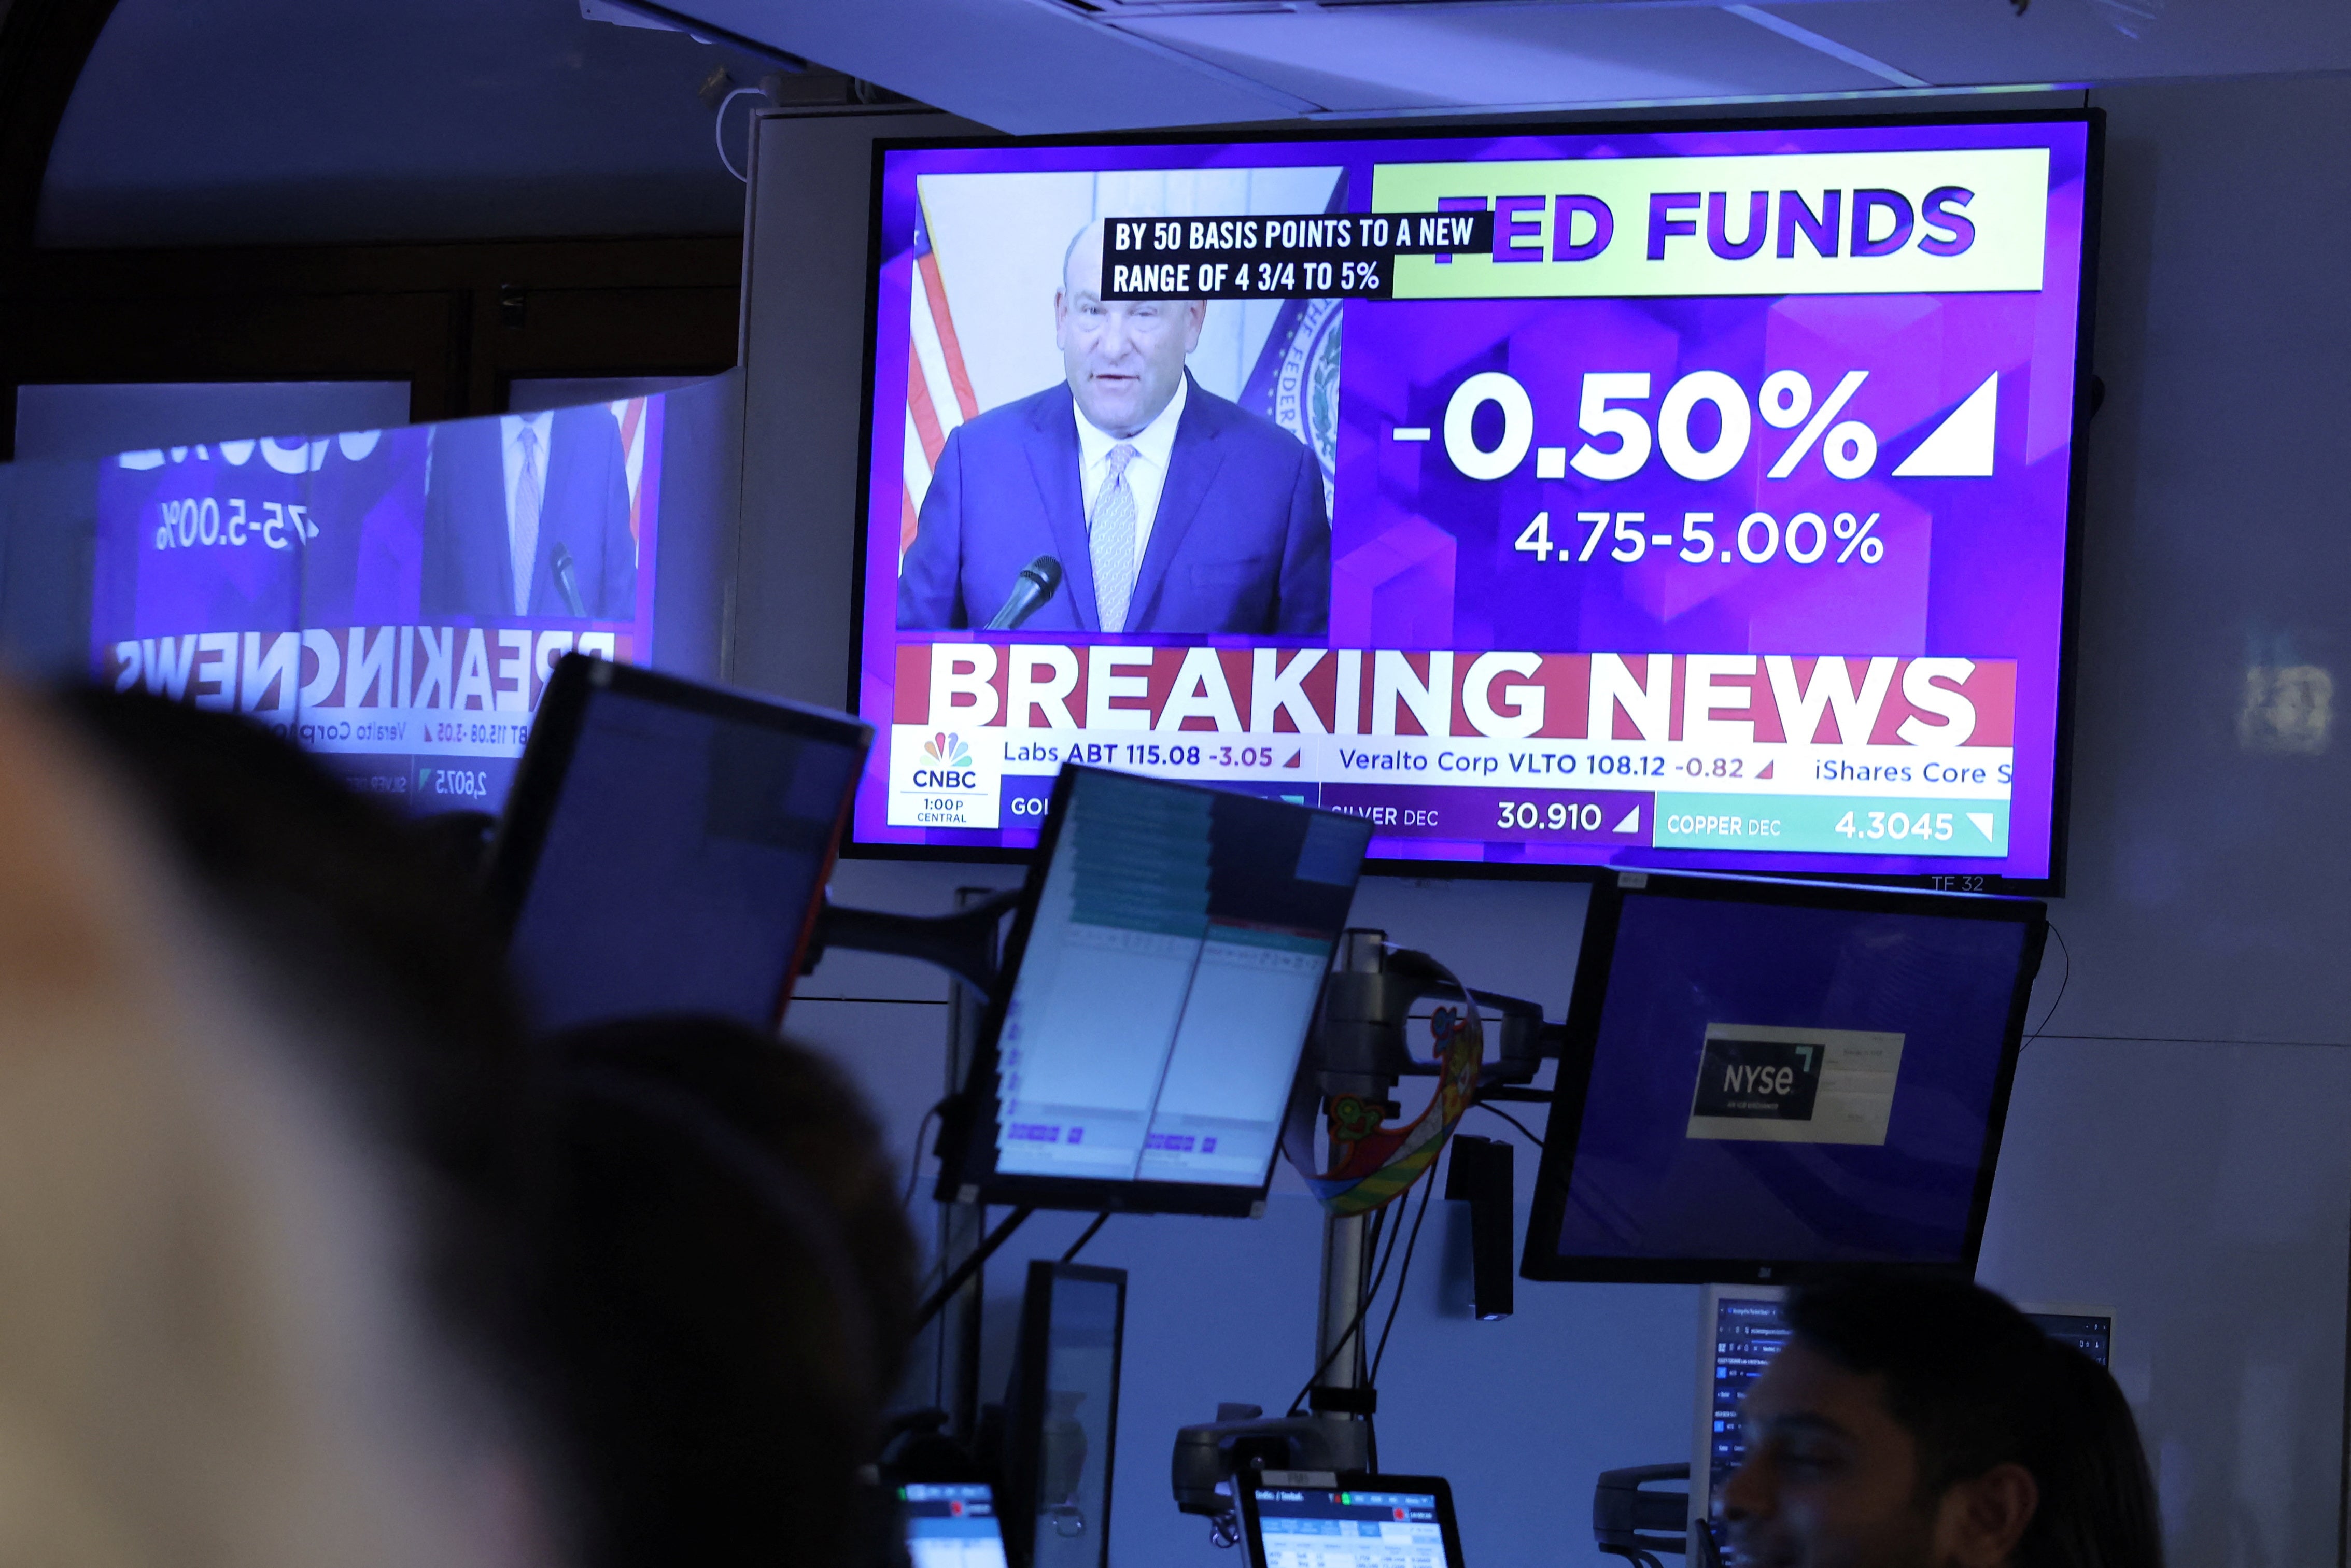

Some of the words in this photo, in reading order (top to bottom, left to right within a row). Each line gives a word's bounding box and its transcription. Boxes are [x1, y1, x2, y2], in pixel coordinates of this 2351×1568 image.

[1116, 222, 1146, 250] BY
[1153, 222, 1181, 250] 50
[1190, 220, 1257, 249] BASIS
[1265, 219, 1350, 249] POINTS
[1359, 218, 1387, 247] TO
[1396, 218, 1411, 246] A
[1419, 218, 1474, 246] NEW
[1646, 185, 1976, 261] FUNDS
[1114, 264, 1189, 292] RANGE
[1198, 263, 1228, 291] OF
[1235, 263, 1250, 291] 4
[1258, 262, 1295, 291] 3/4
[1303, 262, 1332, 290] TO
[1341, 261, 1379, 290] 5%
[1278, 347, 1303, 435] FEDER
[1392, 370, 1878, 481] -0.50%
[1514, 512, 1883, 564] 4.75-5.00%
[928, 643, 1545, 738] BREAKING
[1587, 652, 1977, 747] NEWS
[1004, 741, 1058, 761] Labs
[1066, 743, 1118, 765] ABT
[1126, 744, 1200, 765] 115.08
[1209, 746, 1272, 767] -3.05
[1340, 748, 1428, 770] Veralto
[1438, 750, 1498, 775] Corp
[1509, 753, 1576, 774] VLTO
[1587, 754, 1665, 776] 108.12
[1676, 758, 1743, 778] -0.82
[1815, 759, 1912, 782] iShares
[1923, 762, 1986, 783] Core
[913, 769, 976, 788] CNBC
[917, 813, 967, 823] CENTRAL
[924, 798, 963, 811] 1:00P
[1404, 810, 1438, 826] DEC
[1497, 801, 1602, 830] 30.910
[1667, 814, 1742, 835] COPPER
[1748, 818, 1781, 836] DEC
[1835, 810, 1953, 841] 4.3045
[1962, 875, 1983, 891] 32
